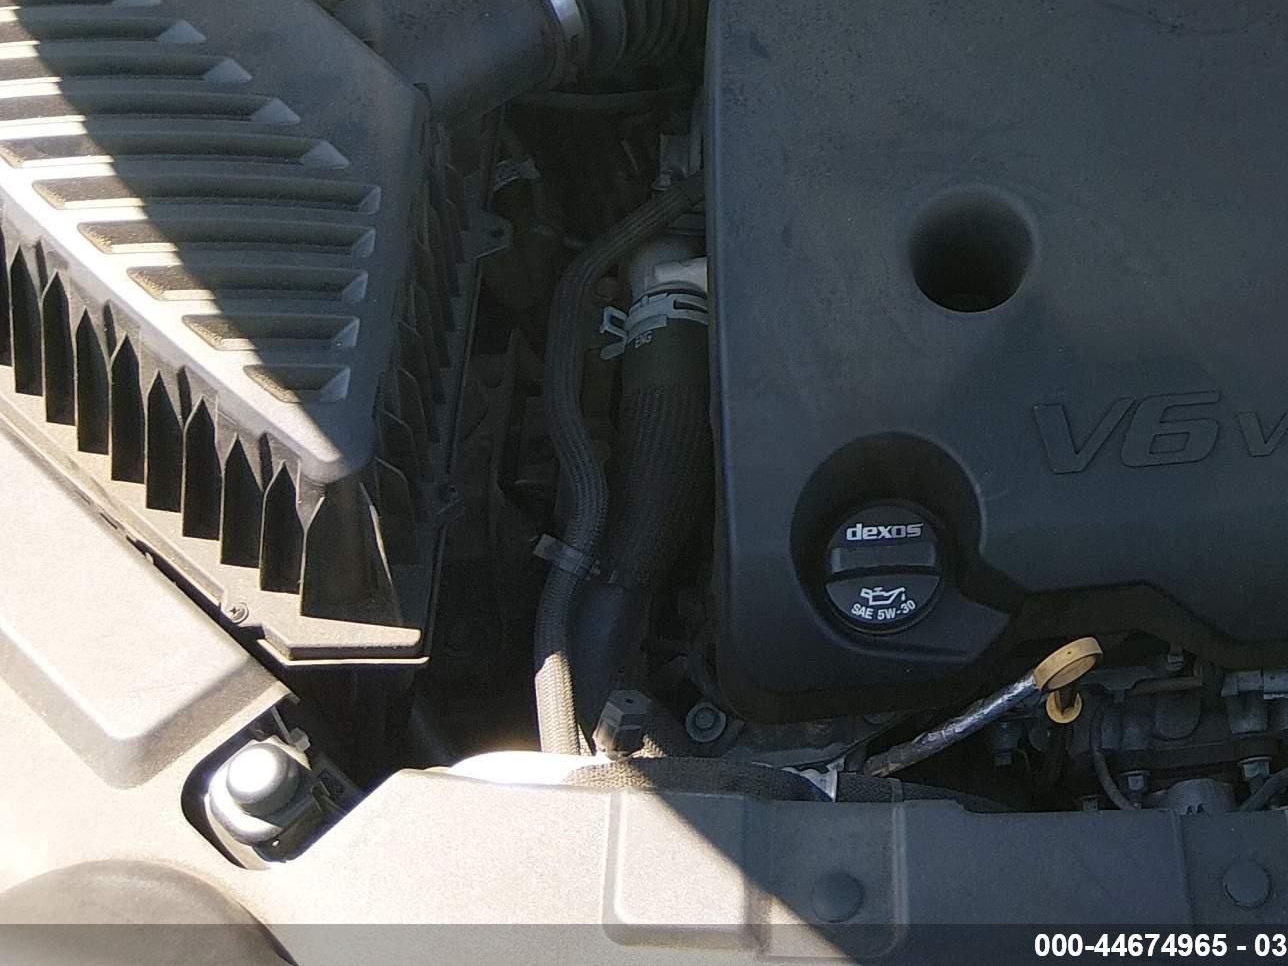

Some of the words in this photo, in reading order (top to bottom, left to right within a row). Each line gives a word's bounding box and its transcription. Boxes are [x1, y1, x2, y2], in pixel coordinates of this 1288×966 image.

[1033, 390, 1222, 474] V6
[846, 523, 924, 541] dexos
[851, 603, 874, 619] SAE
[877, 600, 916, 620] 5W-30
